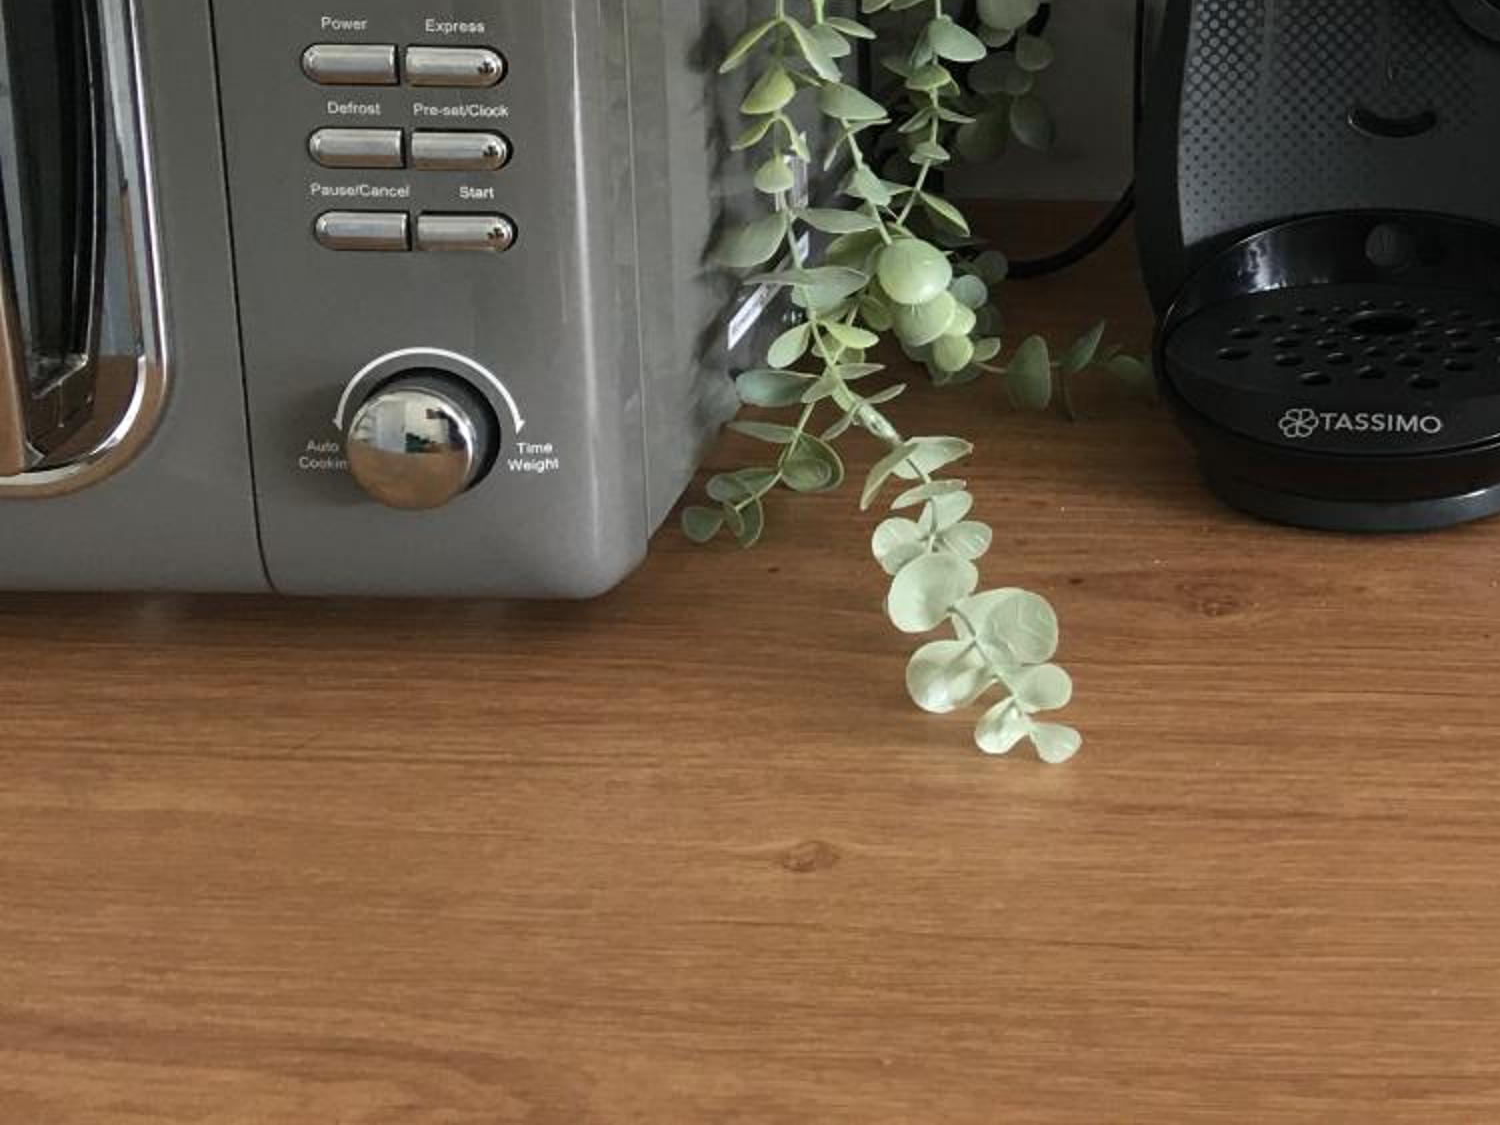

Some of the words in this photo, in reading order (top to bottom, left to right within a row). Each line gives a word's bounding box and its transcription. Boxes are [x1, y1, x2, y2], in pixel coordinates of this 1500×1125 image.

[321, 16, 368, 31] Power
[424, 18, 485, 35] Express
[327, 101, 381, 116] Defrost
[413, 102, 509, 118] Pre-set/Clock
[310, 183, 411, 198] Pause/Cancel
[459, 186, 495, 200] Start
[1319, 412, 1443, 434] TASSIMO
[307, 440, 339, 453] Auto
[516, 442, 553, 454] Time
[299, 456, 349, 470] Cookin
[507, 457, 559, 473] Weight
